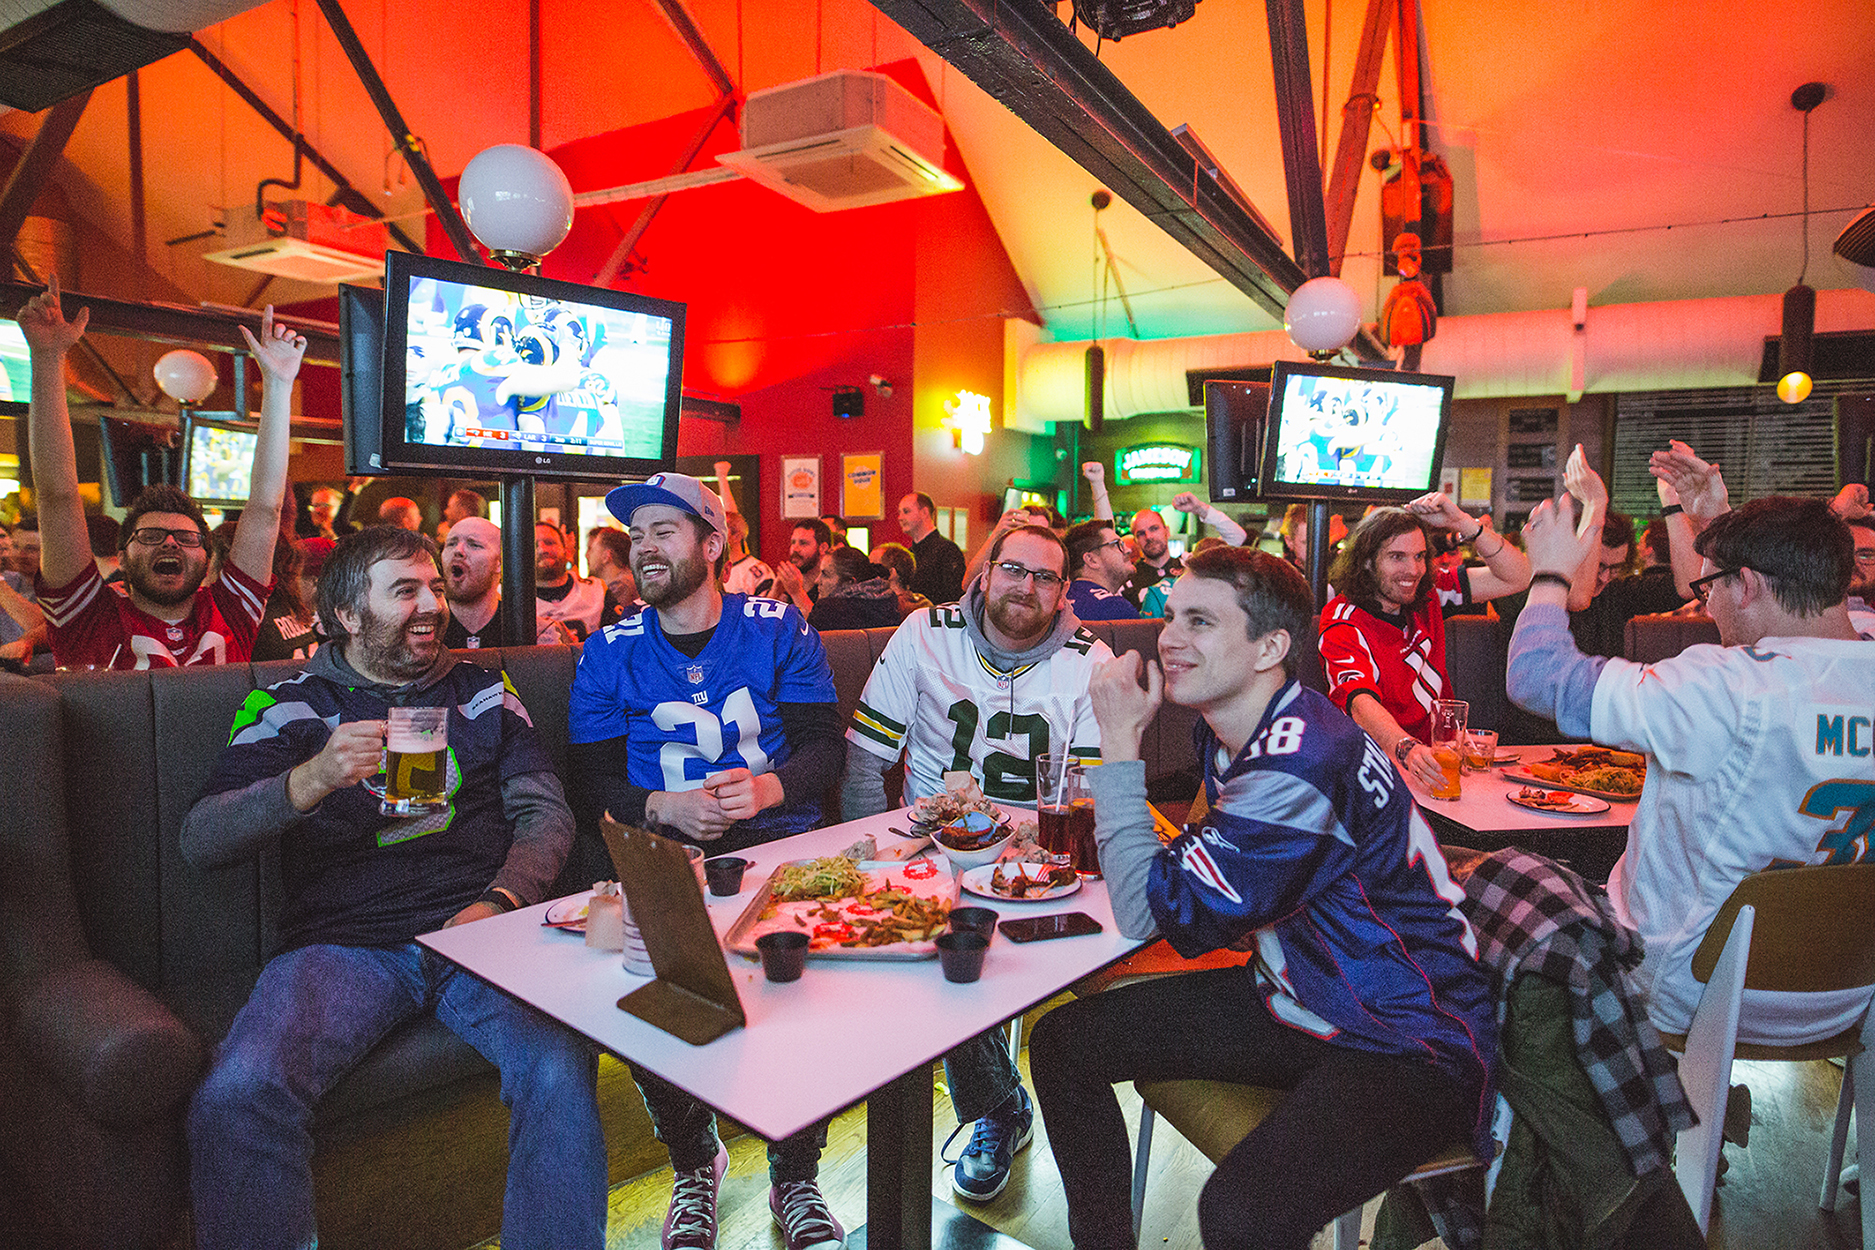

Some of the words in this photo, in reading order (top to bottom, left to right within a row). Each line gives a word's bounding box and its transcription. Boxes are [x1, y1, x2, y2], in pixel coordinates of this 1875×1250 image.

[500, 431, 506, 440] 3
[650, 686, 774, 793] 21
[941, 698, 1050, 801] 12
